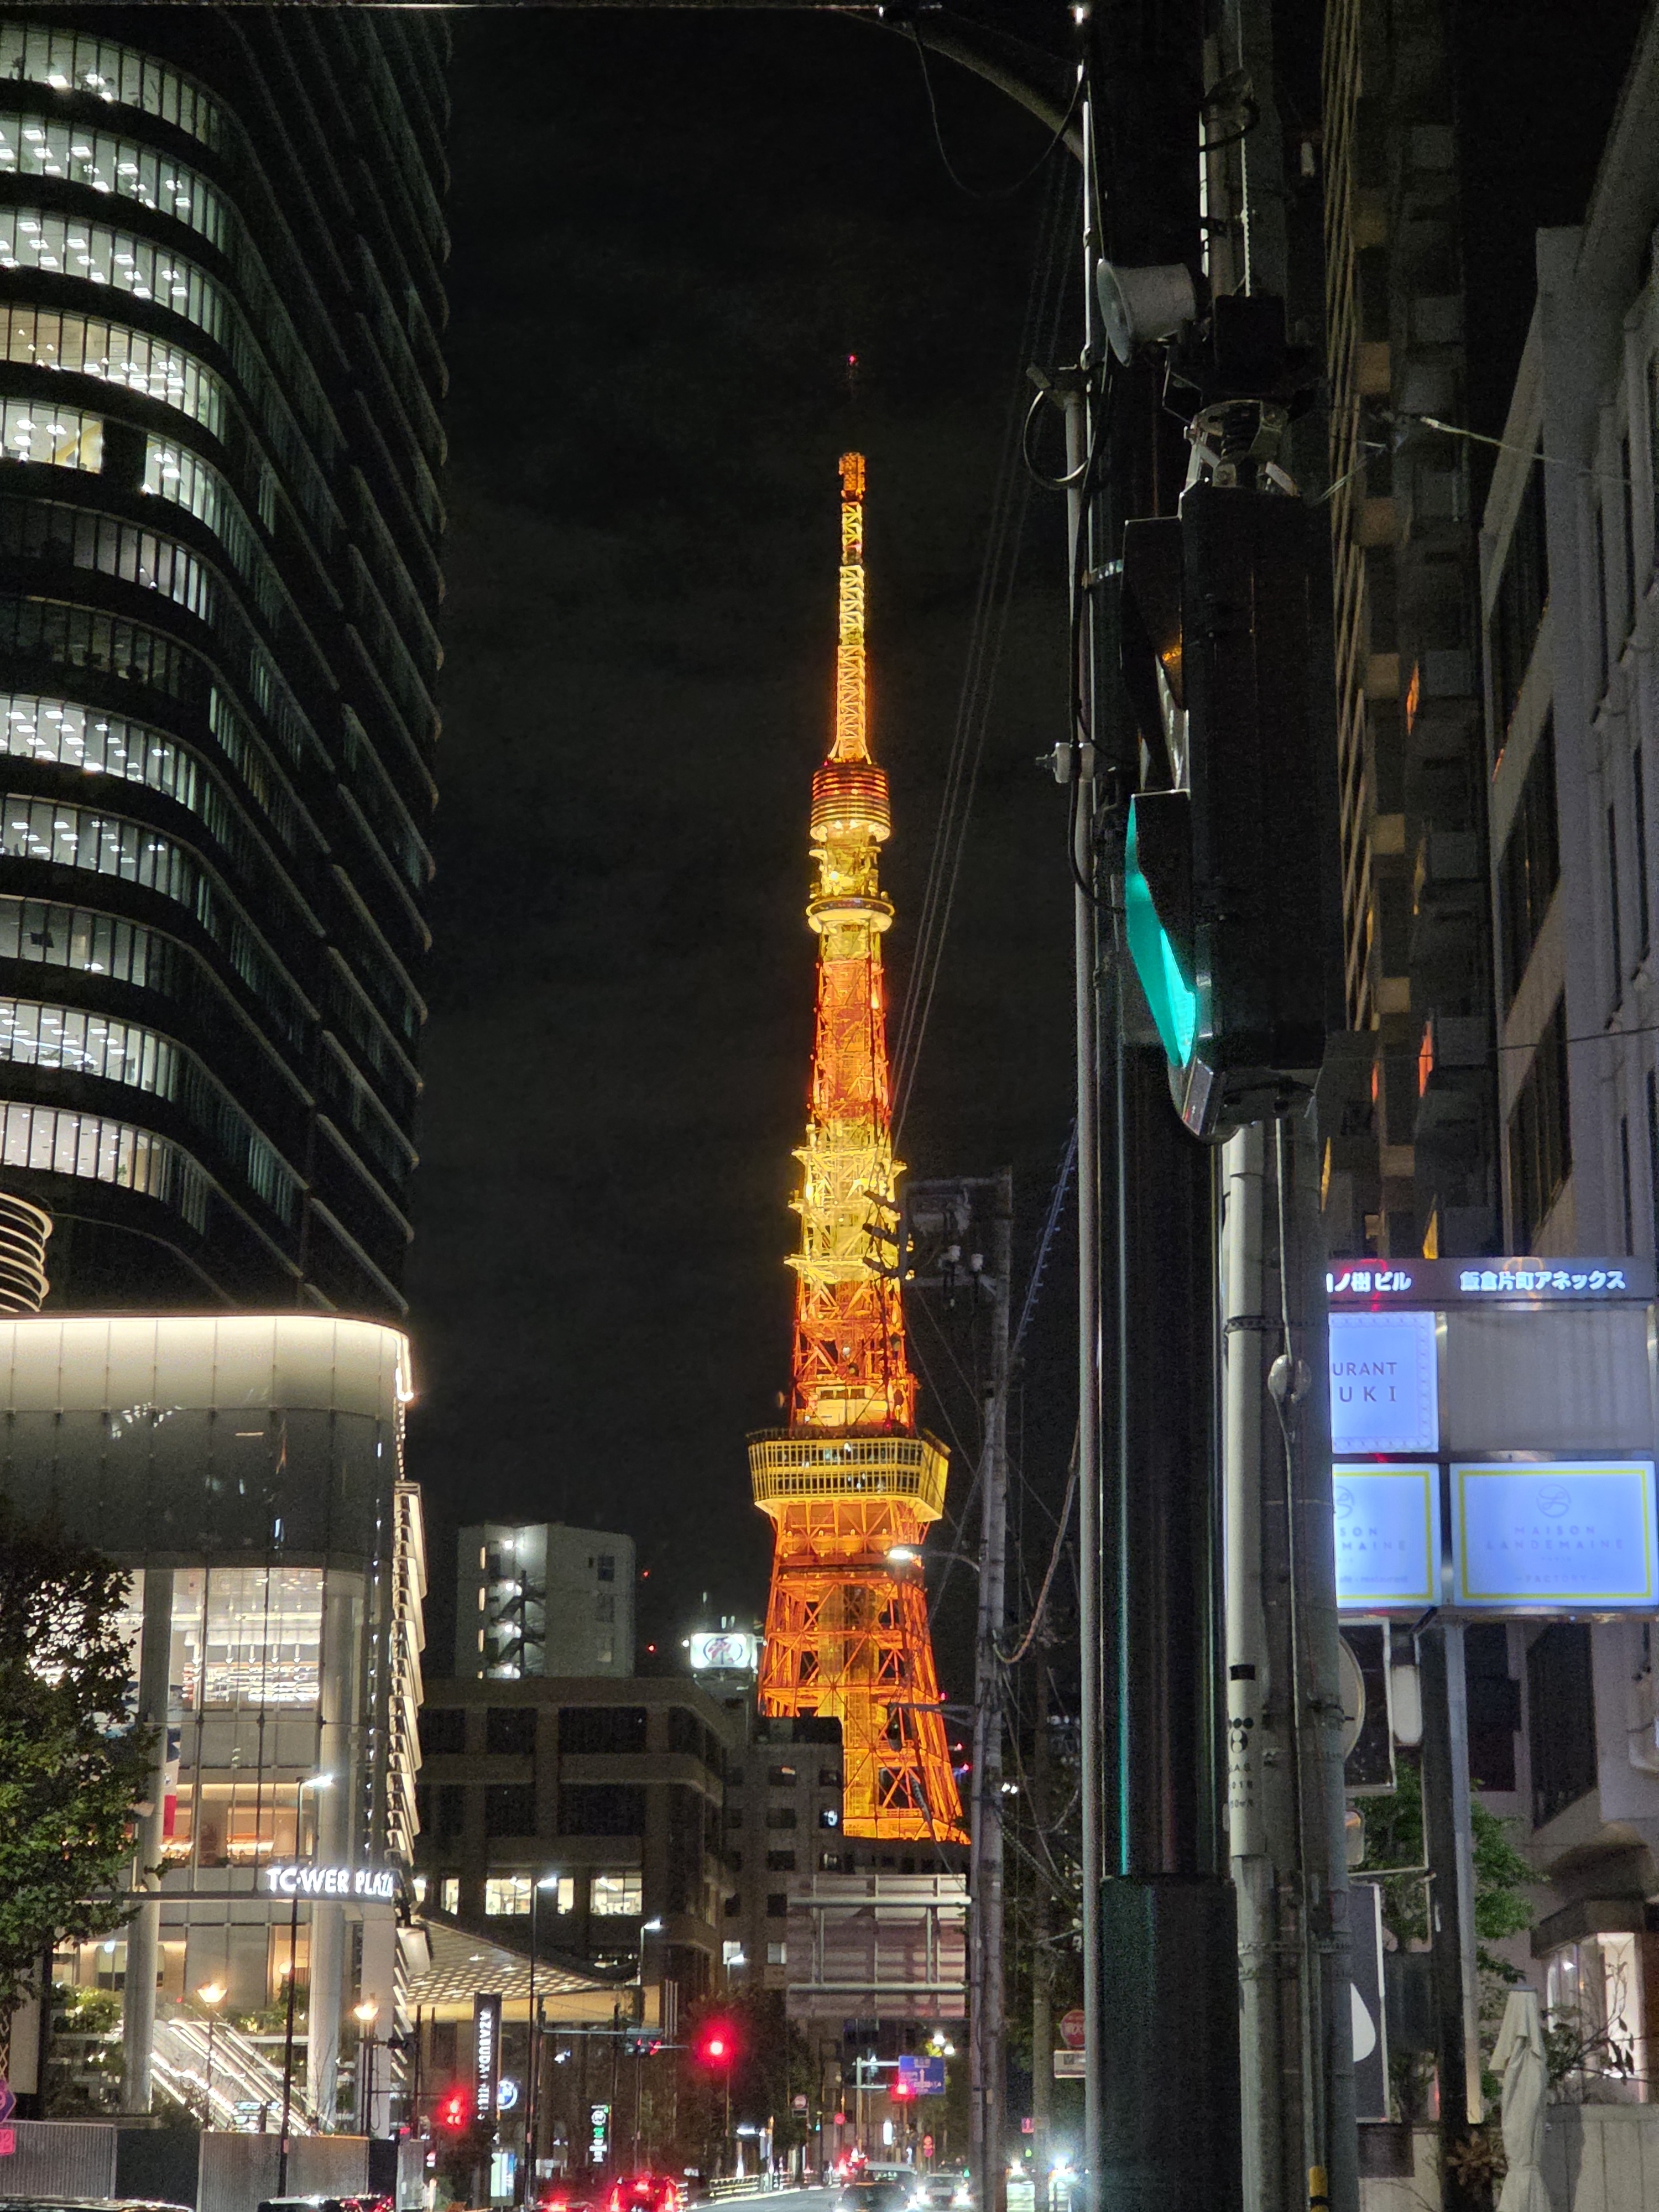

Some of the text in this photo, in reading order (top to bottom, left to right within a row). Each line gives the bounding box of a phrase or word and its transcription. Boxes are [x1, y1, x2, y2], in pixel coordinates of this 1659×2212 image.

[1514, 1525, 1595, 1536] MAISON
[1486, 1538, 1624, 1551] LANDEMAINE
[265, 1866, 394, 1898] TOWER PLAZA
